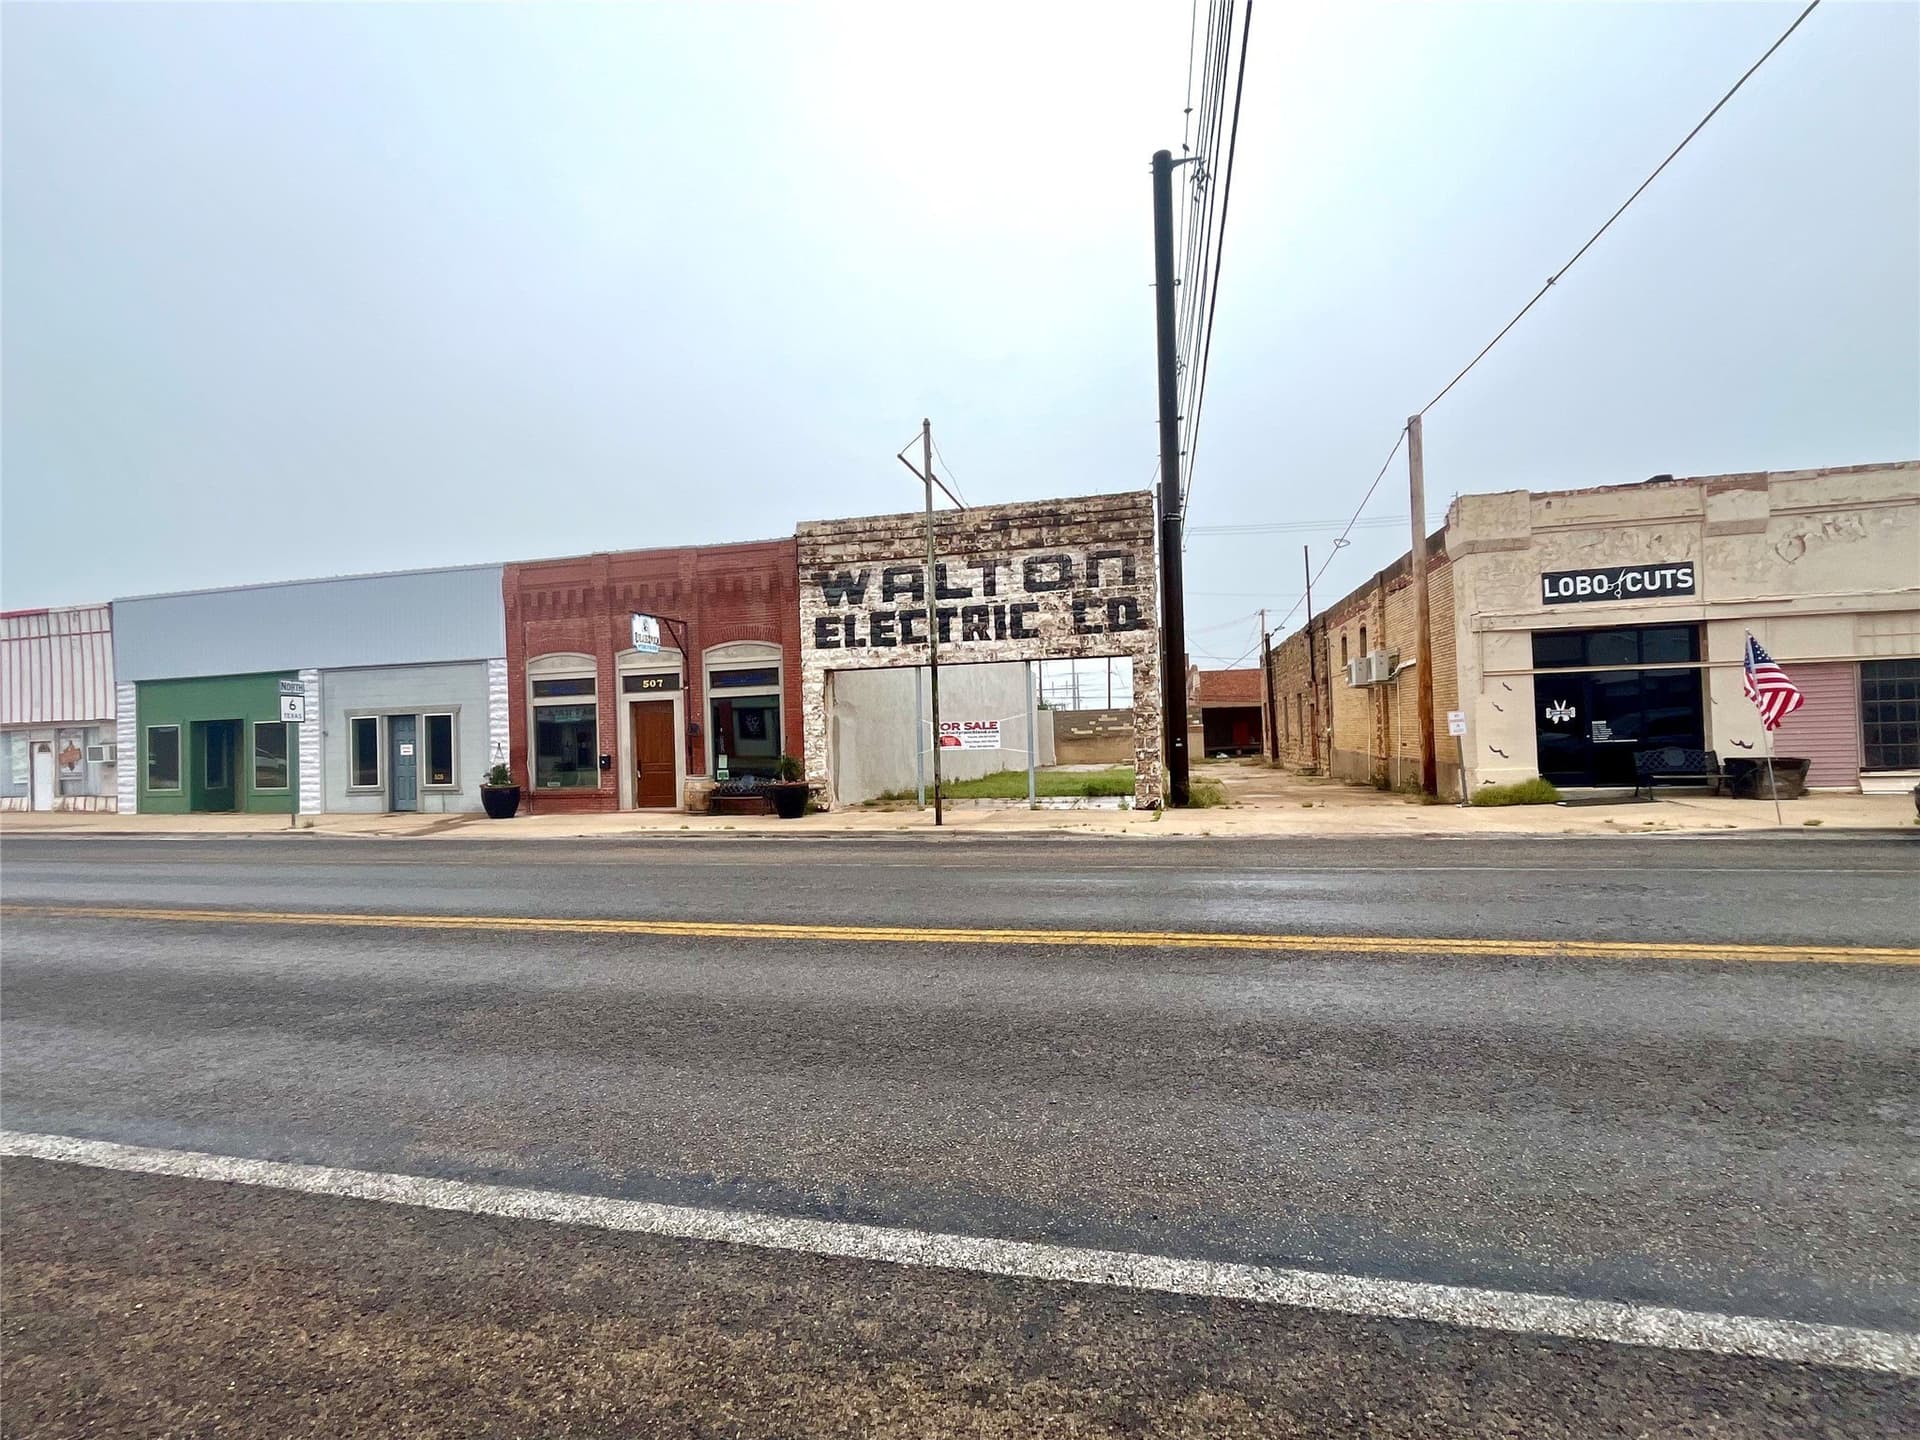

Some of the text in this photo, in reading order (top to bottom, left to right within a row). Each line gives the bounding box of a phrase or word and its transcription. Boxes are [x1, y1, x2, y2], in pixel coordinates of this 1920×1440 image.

[811, 549, 1135, 606] WALTON
[1543, 568, 1693, 597] LOBO CUTS
[815, 602, 1040, 649] ELECTRIC
[281, 682, 303, 691] NORTH
[642, 679, 664, 688] 507
[289, 699, 296, 711] 6
[964, 721, 997, 730] SALE
